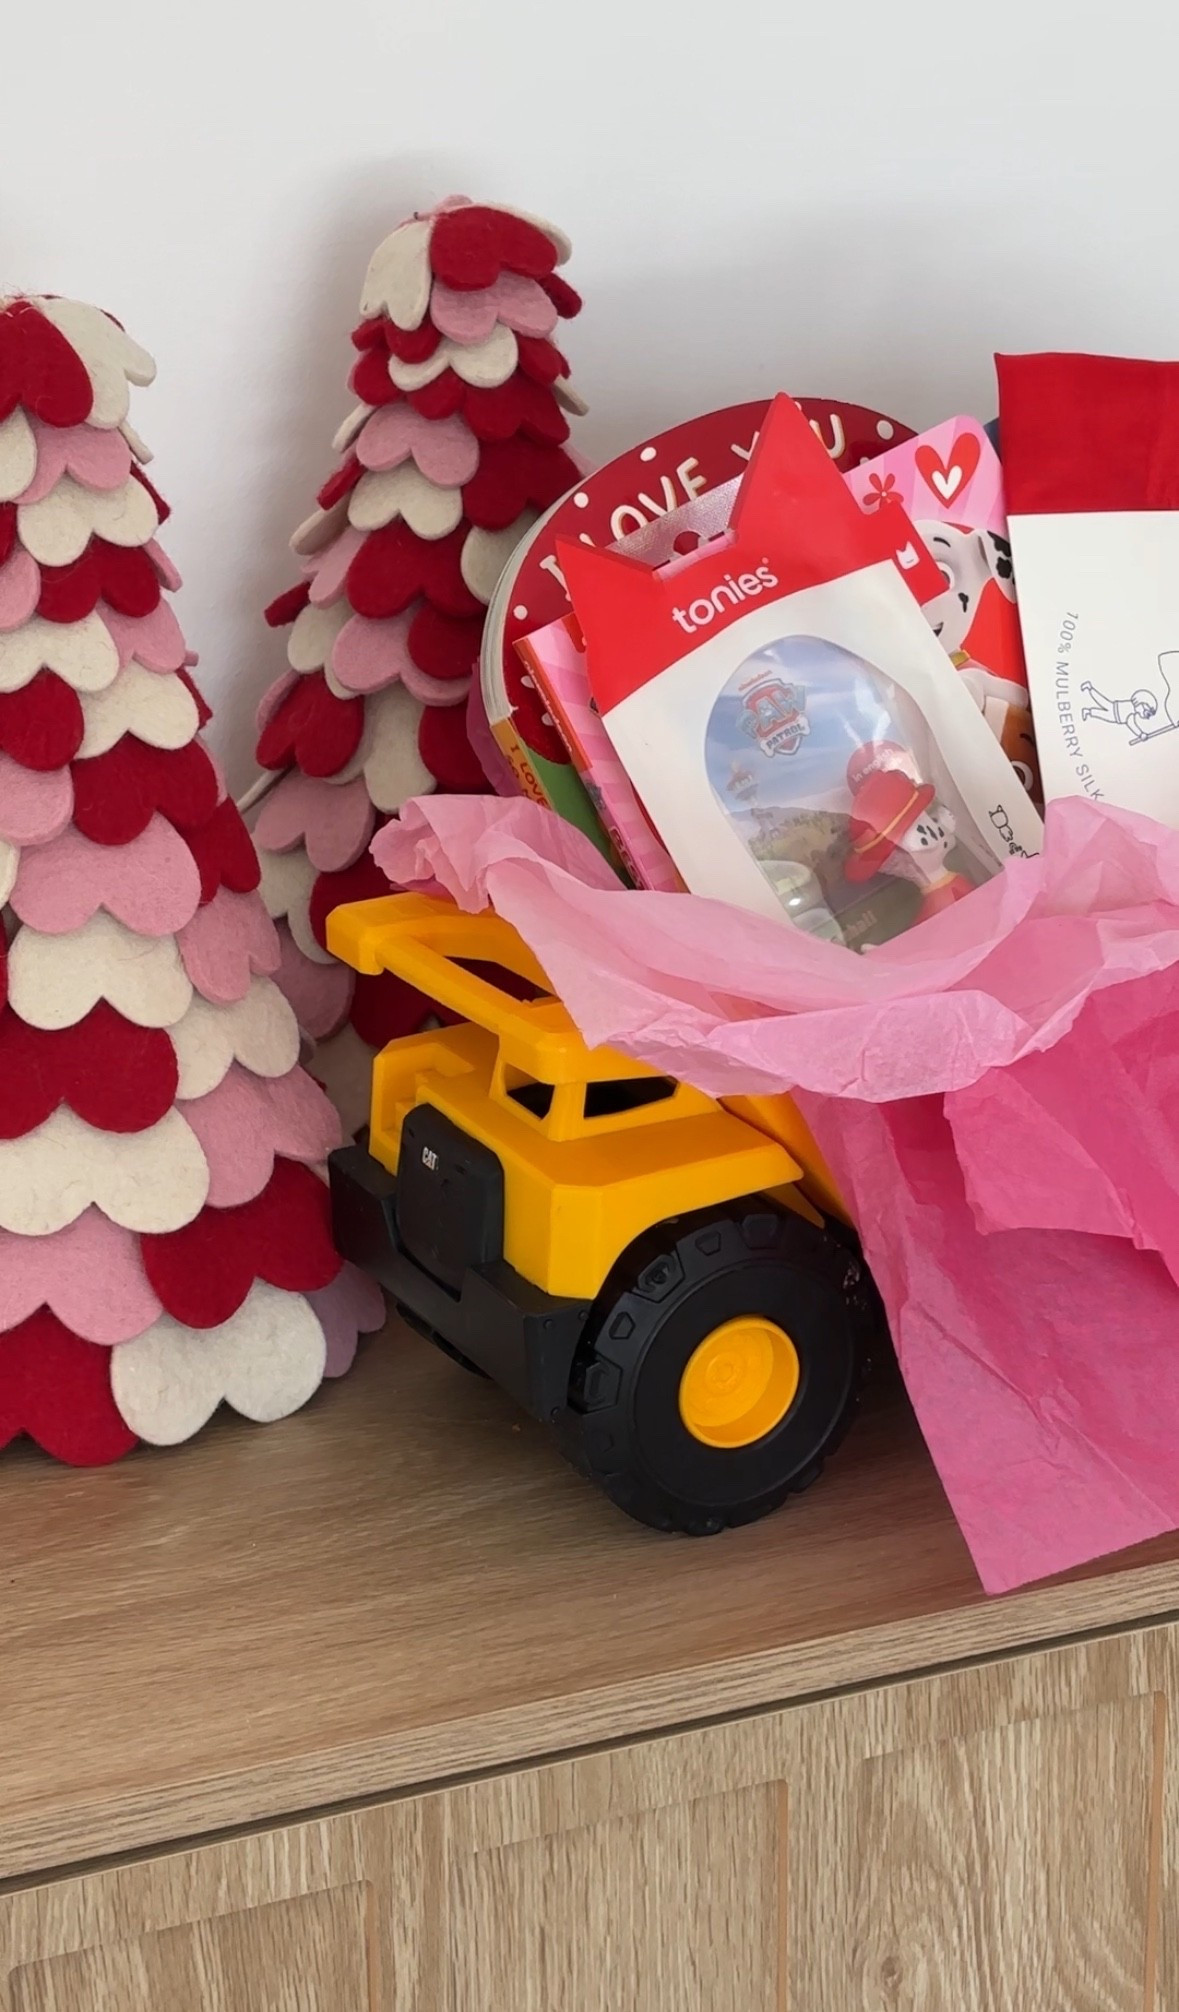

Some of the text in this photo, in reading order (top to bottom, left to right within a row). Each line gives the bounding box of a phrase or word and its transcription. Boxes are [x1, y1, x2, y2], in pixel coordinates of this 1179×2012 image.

[731, 413, 846, 460] YU
[671, 563, 779, 634] tonies
[1055, 612, 1105, 800] 100% MULBERRY SILK
[766, 723, 806, 749] PATROL
[422, 1146, 438, 1170] CAT
